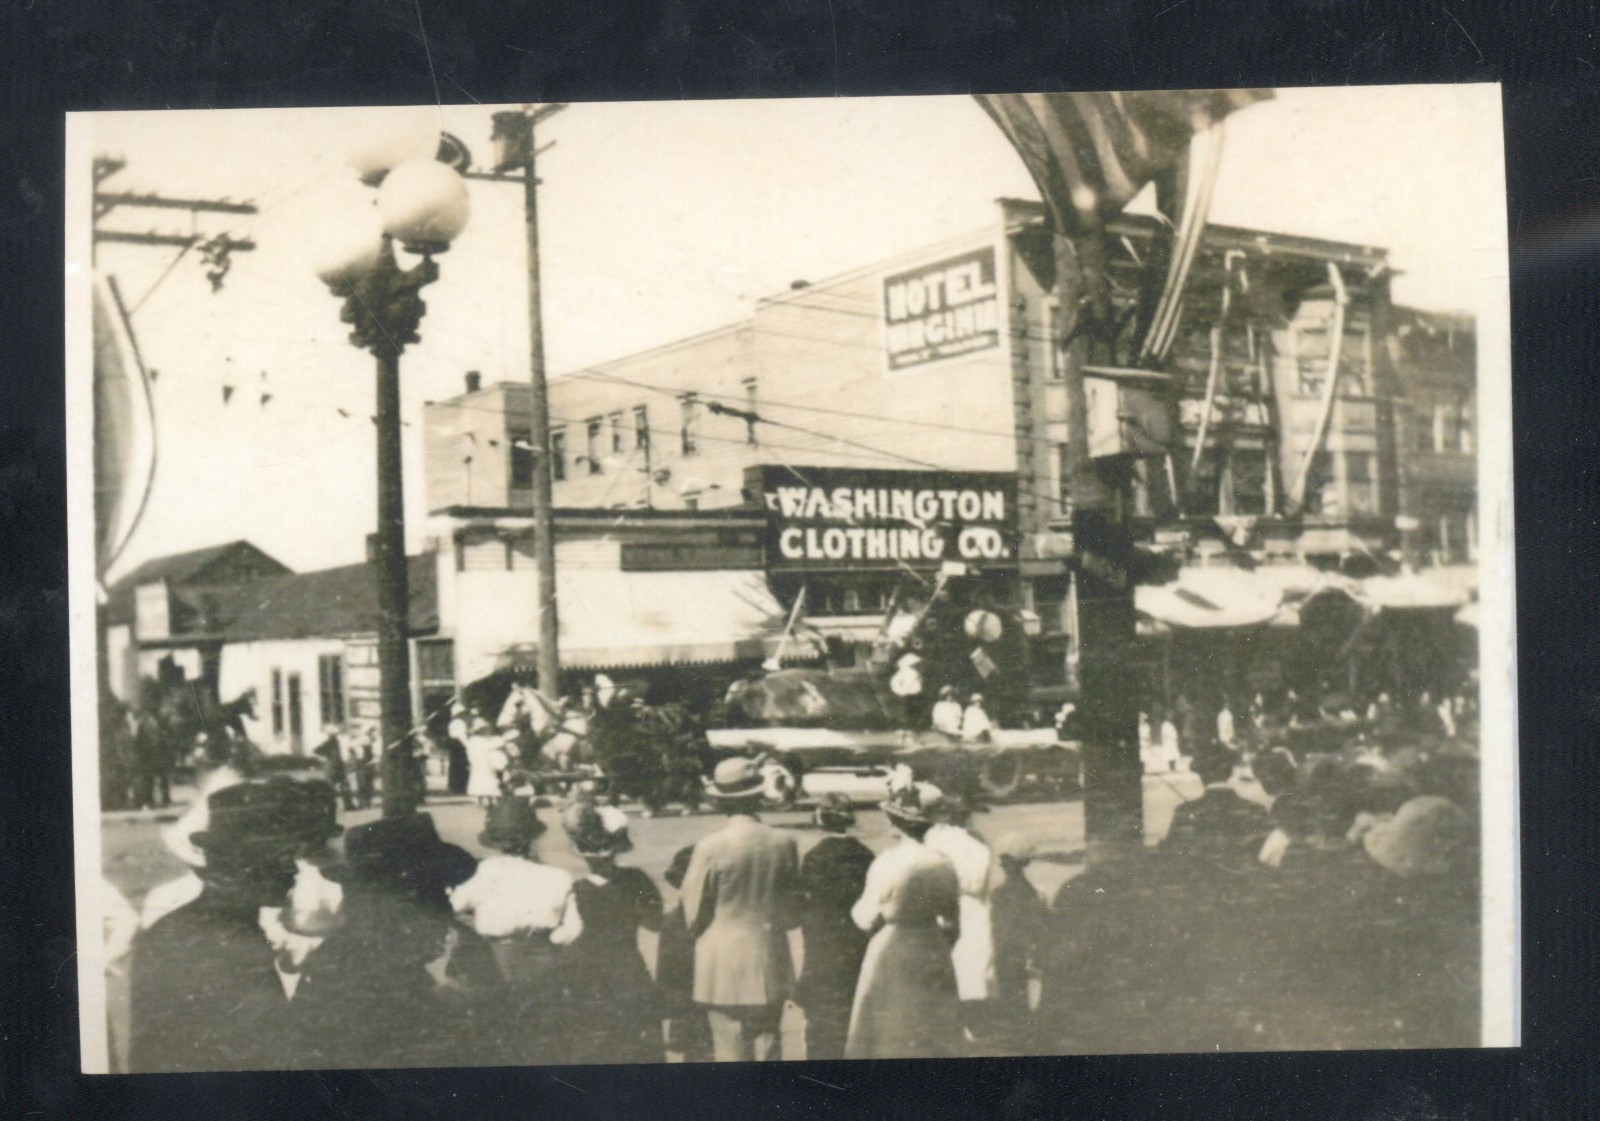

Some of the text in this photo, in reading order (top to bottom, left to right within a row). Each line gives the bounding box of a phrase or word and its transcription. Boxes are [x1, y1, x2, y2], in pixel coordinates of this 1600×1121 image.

[888, 262, 996, 320] HOTEL
[777, 487, 1005, 520] WASHINGTON
[779, 527, 1010, 559] CLOTHING CO.
